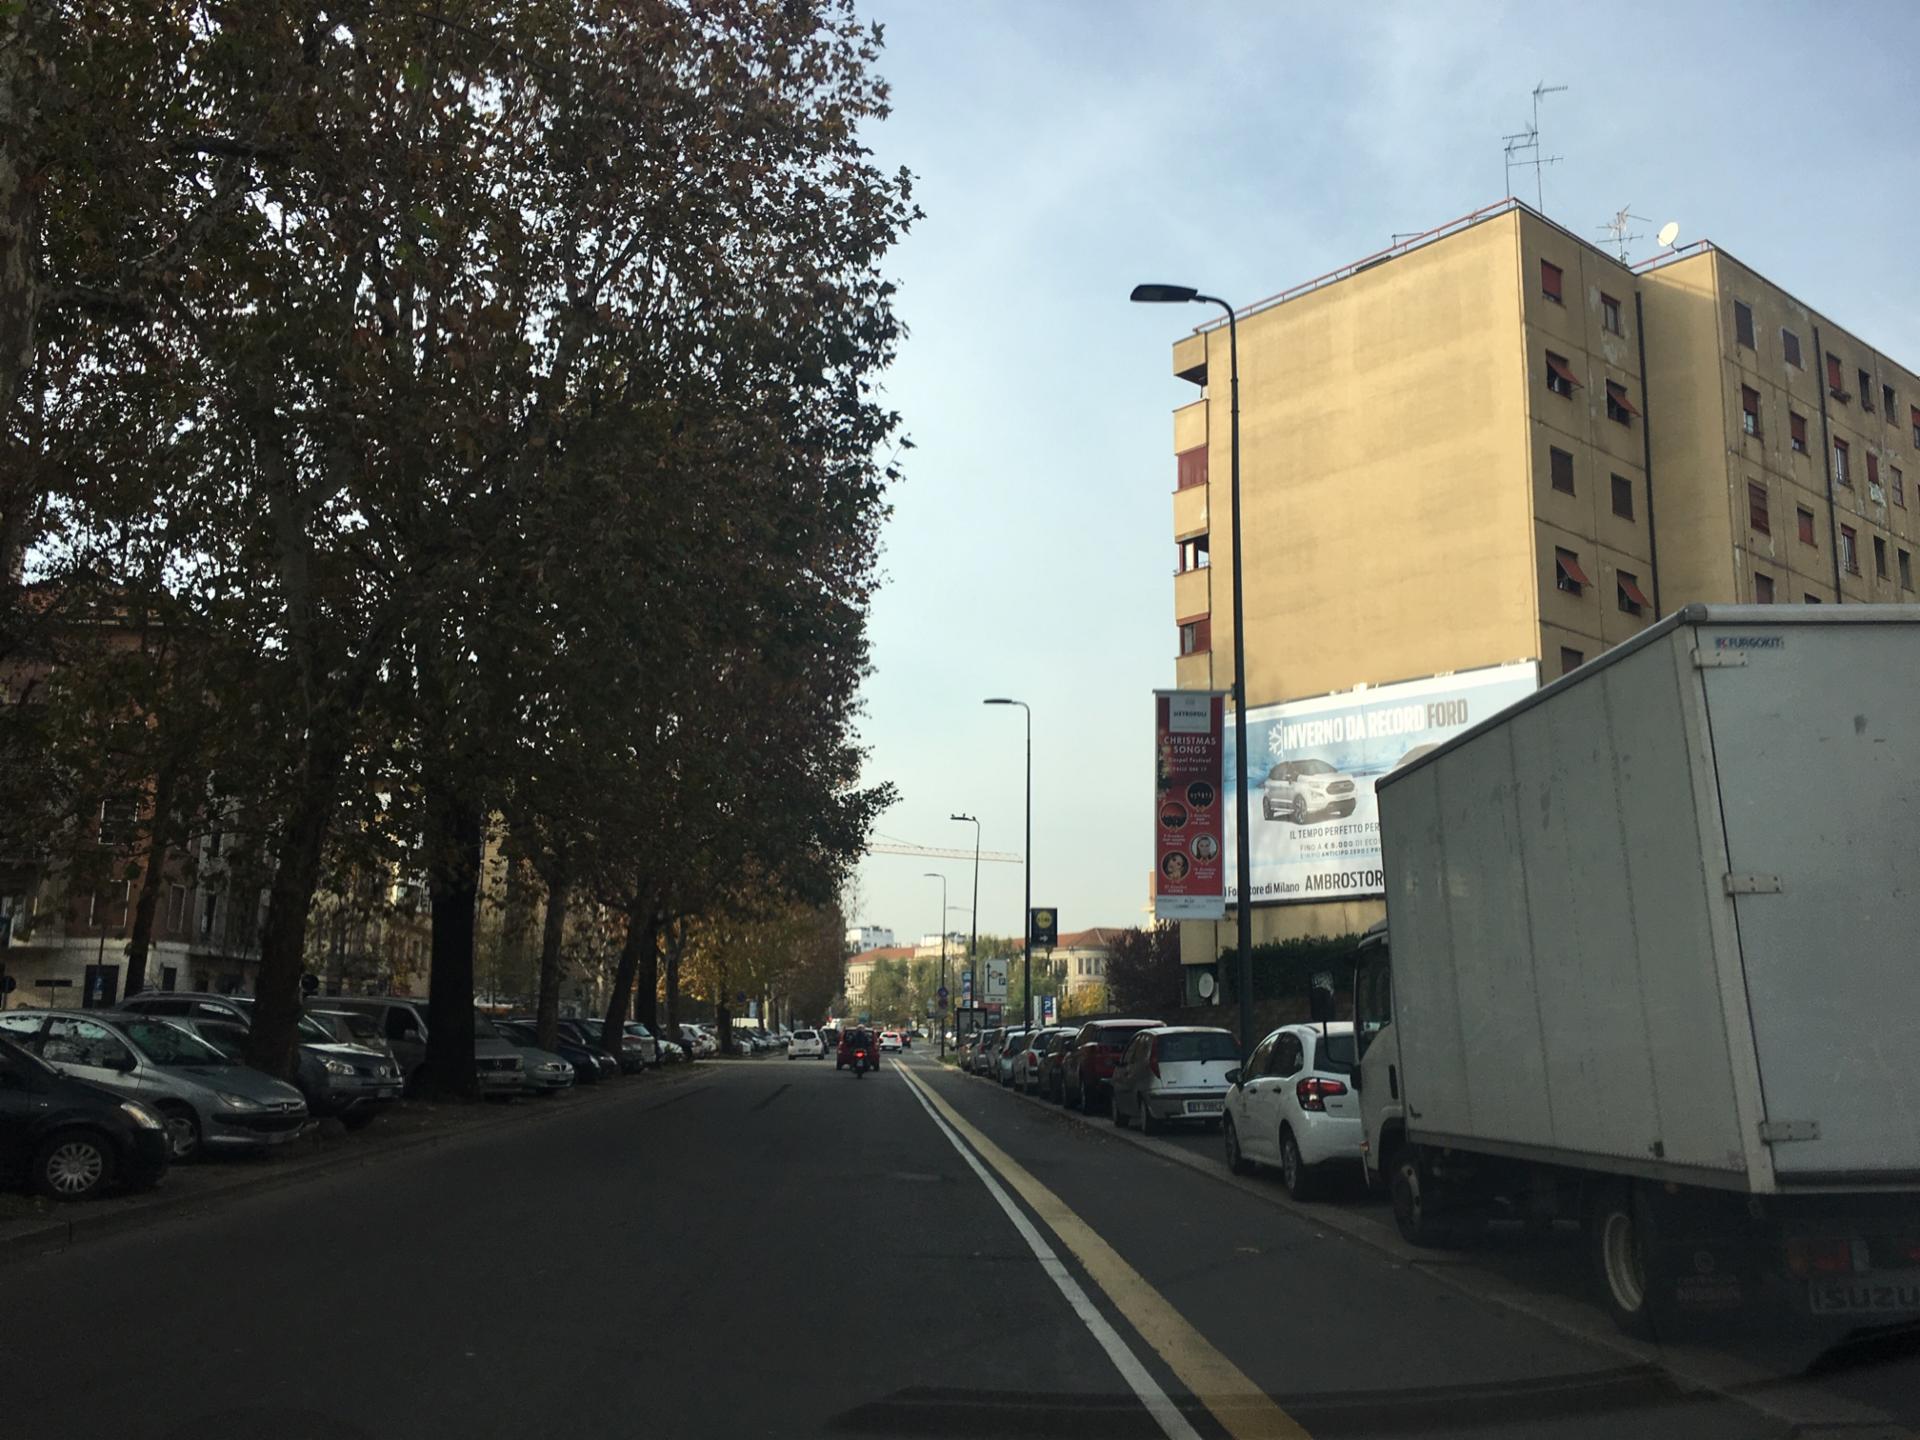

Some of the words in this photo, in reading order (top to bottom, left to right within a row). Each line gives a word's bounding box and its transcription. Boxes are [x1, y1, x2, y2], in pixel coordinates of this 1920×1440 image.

[1283, 717, 1343, 750] INVERNO
[1346, 714, 1366, 742] DA
[1367, 705, 1425, 738] RECORD
[1427, 698, 1468, 729] FORD
[1164, 736, 1216, 745] CHRISTMAS
[1173, 746, 1207, 754] SONGS
[1289, 831, 1296, 840] IL
[1298, 827, 1323, 839] TEMPO
[1324, 824, 1363, 836] PERFETTO
[1365, 822, 1380, 833] PER
[1228, 885, 1264, 897] Fotore
[1265, 883, 1272, 894] di
[1273, 882, 1299, 894] Milano
[1305, 869, 1384, 891] AMBROSTOR
